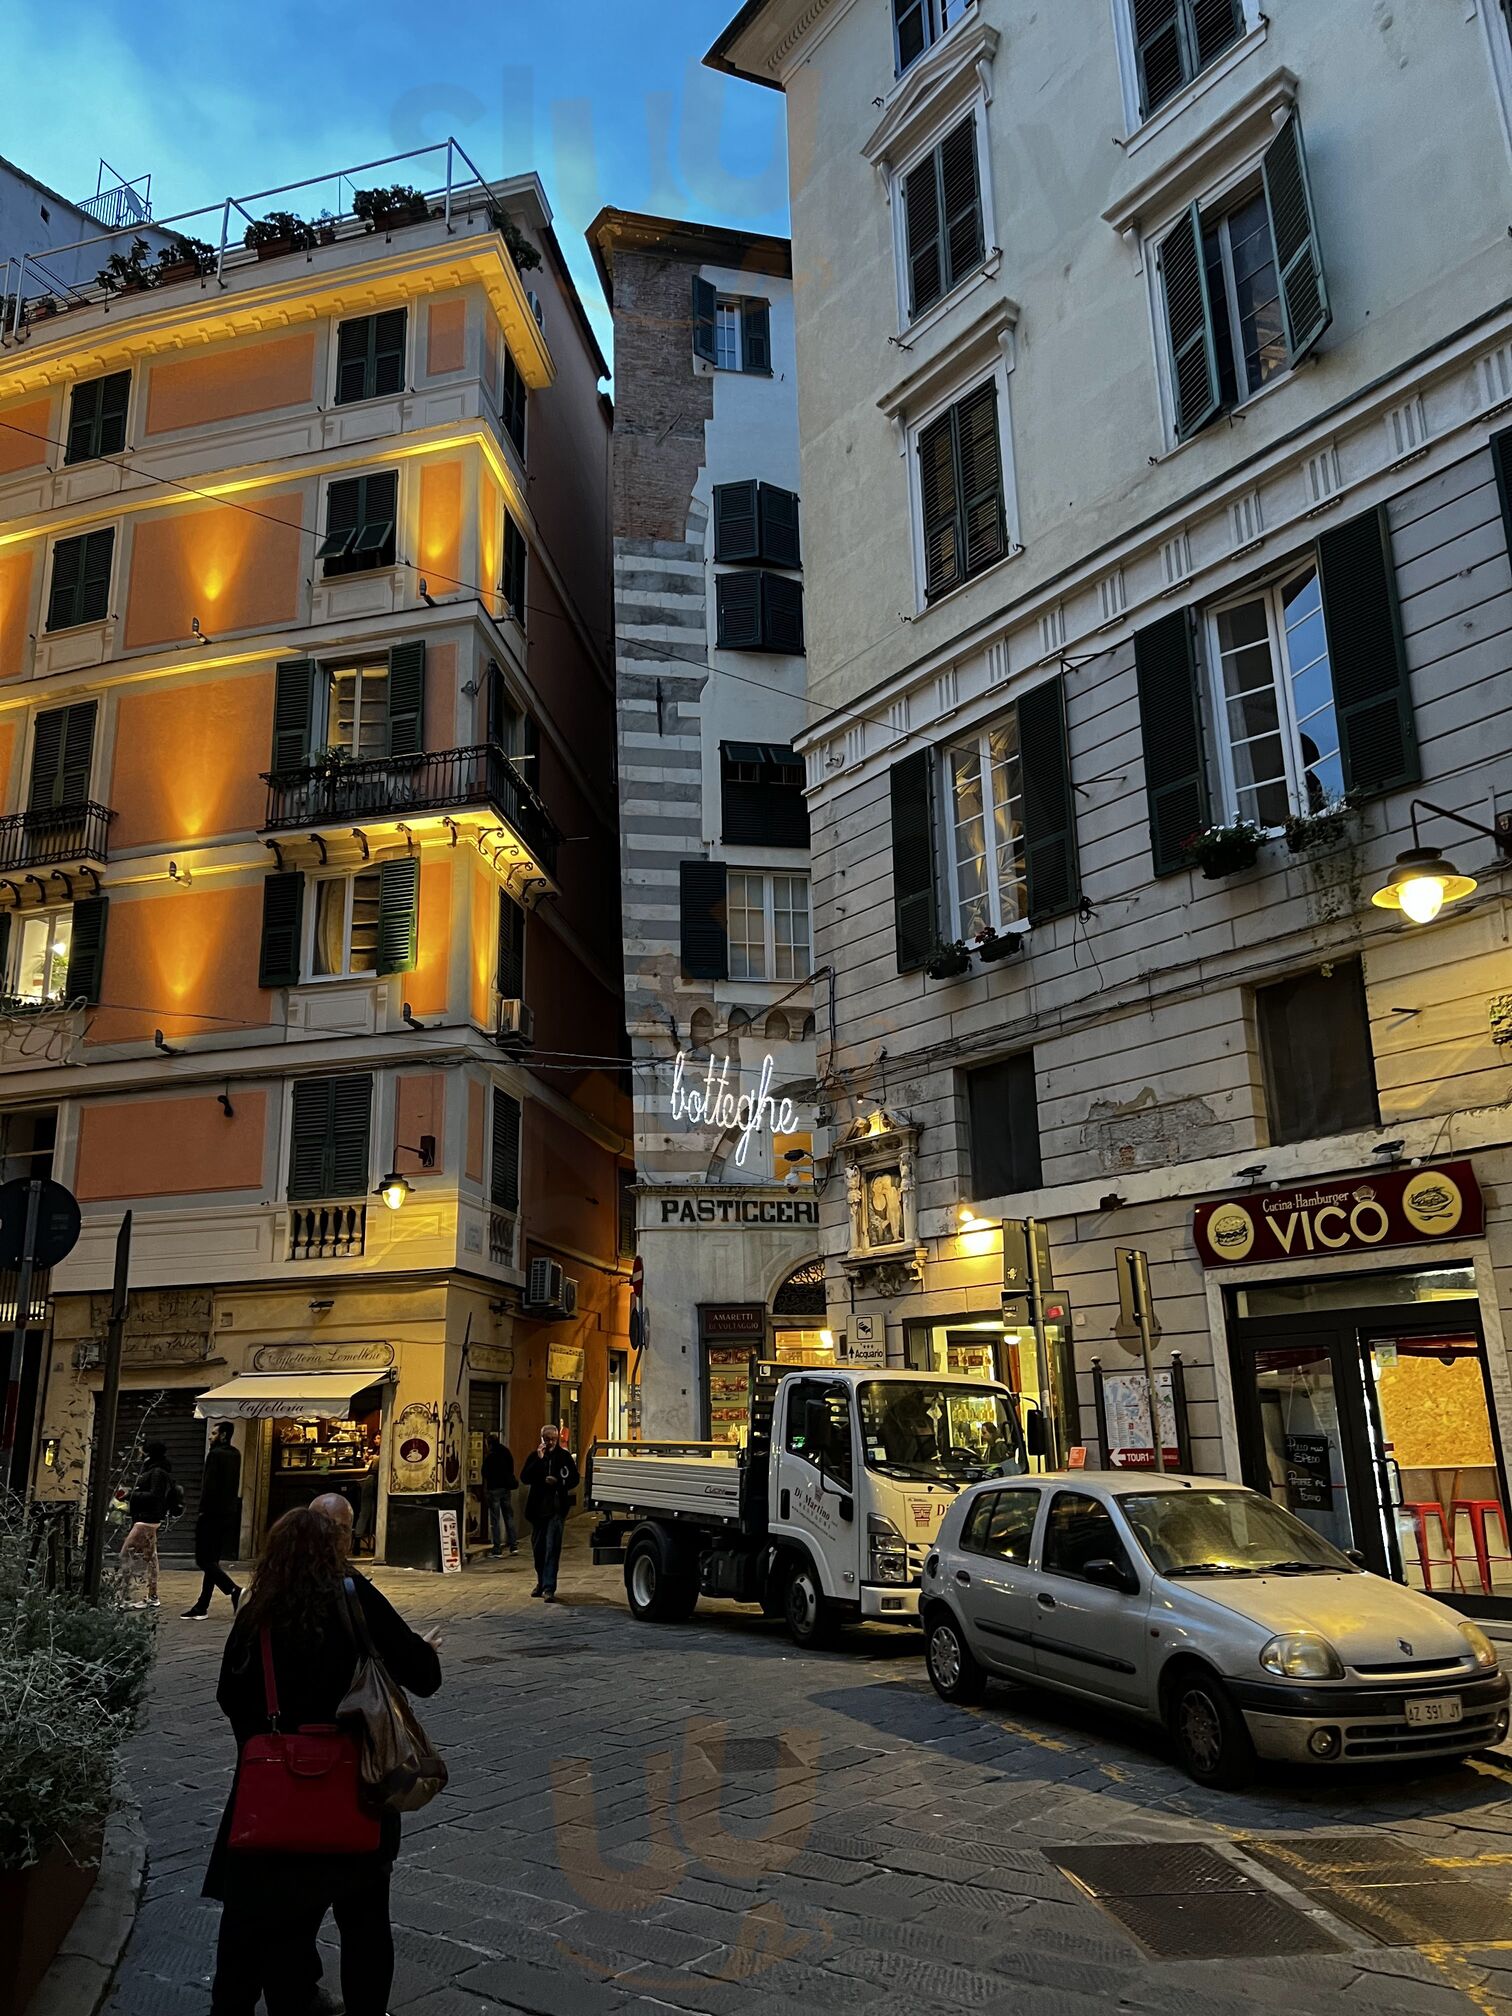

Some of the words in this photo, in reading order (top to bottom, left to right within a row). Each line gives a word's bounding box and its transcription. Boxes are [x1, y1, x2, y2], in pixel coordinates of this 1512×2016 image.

[670, 1050, 799, 1167] botteghe
[718, 1322, 759, 1330] VOLTAGGIO
[855, 1348, 883, 1359] Acquario
[238, 1400, 305, 1417] Caffetteria
[805, 1494, 831, 1521] Martino
[1425, 1704, 1444, 1720] 391
